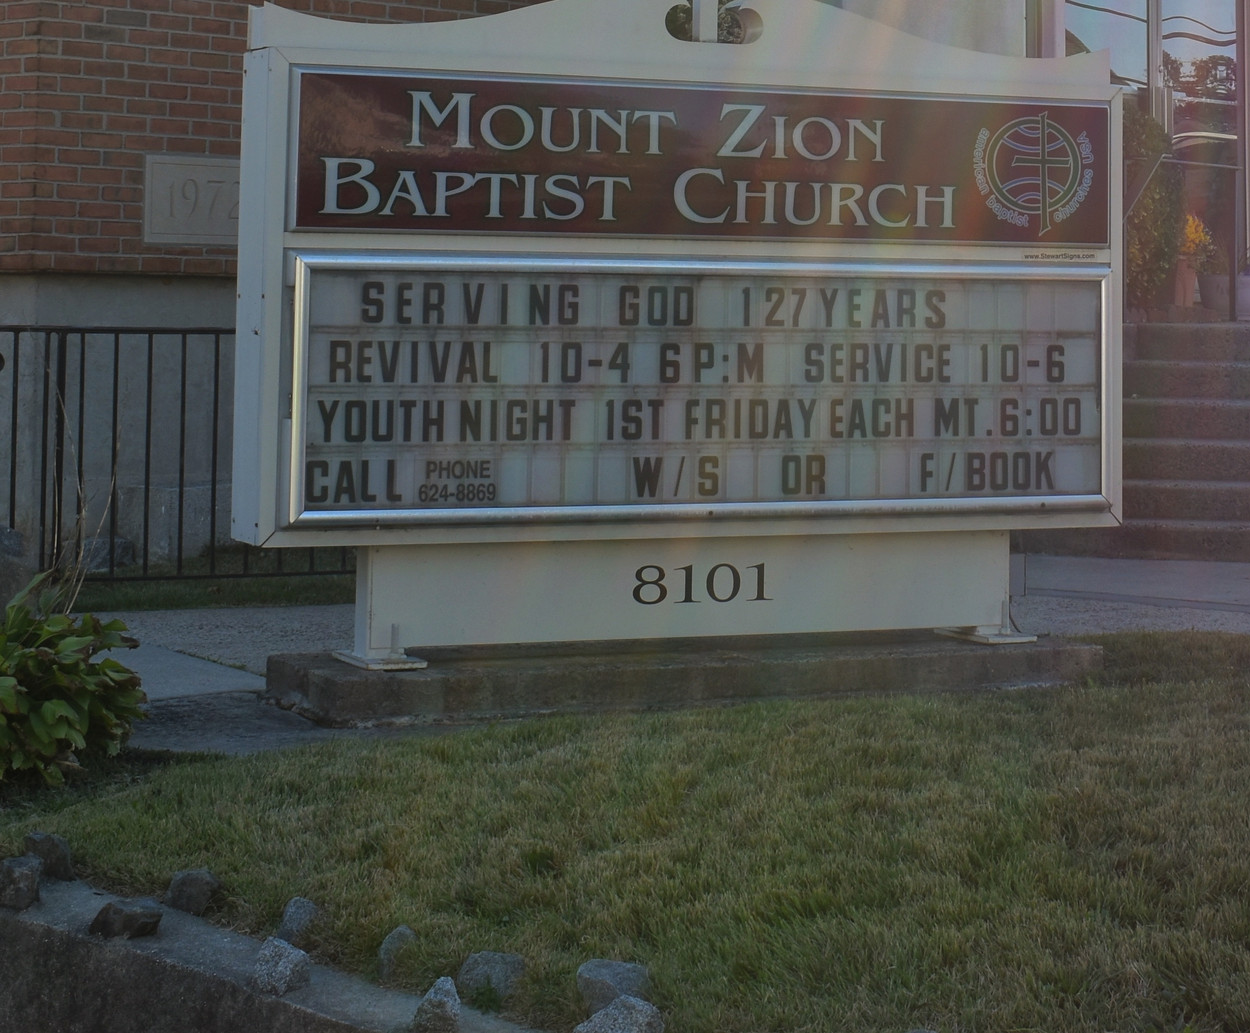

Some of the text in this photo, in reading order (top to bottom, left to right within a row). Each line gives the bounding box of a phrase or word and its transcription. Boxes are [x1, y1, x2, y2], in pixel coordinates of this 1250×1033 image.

[405, 90, 887, 162] MOUNT ZION
[318, 156, 957, 228] BAPTIST CHURCH
[973, 127, 990, 195] american
[985, 194, 1029, 227] baptist
[1076, 130, 1095, 164] USA
[1024, 252, 1095, 260] www.StewartSigns.com
[361, 281, 580, 326] SERVING
[618, 284, 695, 327] GOD
[329, 339, 499, 384] REVIVAL
[540, 342, 631, 384] 10-4
[804, 342, 952, 384] SERVICE
[980, 343, 1065, 384] 10-6
[316, 399, 445, 443] YOUTH
[459, 398, 577, 443] NIGHT
[605, 398, 665, 441] 1ST
[684, 397, 817, 441] FRIDAY
[829, 397, 915, 439] EACH
[305, 458, 403, 504] CALL
[781, 454, 827, 496] OR
[919, 451, 1055, 493] F/BOOK
[425, 460, 491, 479] PHONE
[418, 483, 497, 503] 624-8869
[632, 562, 775, 605] 8101
